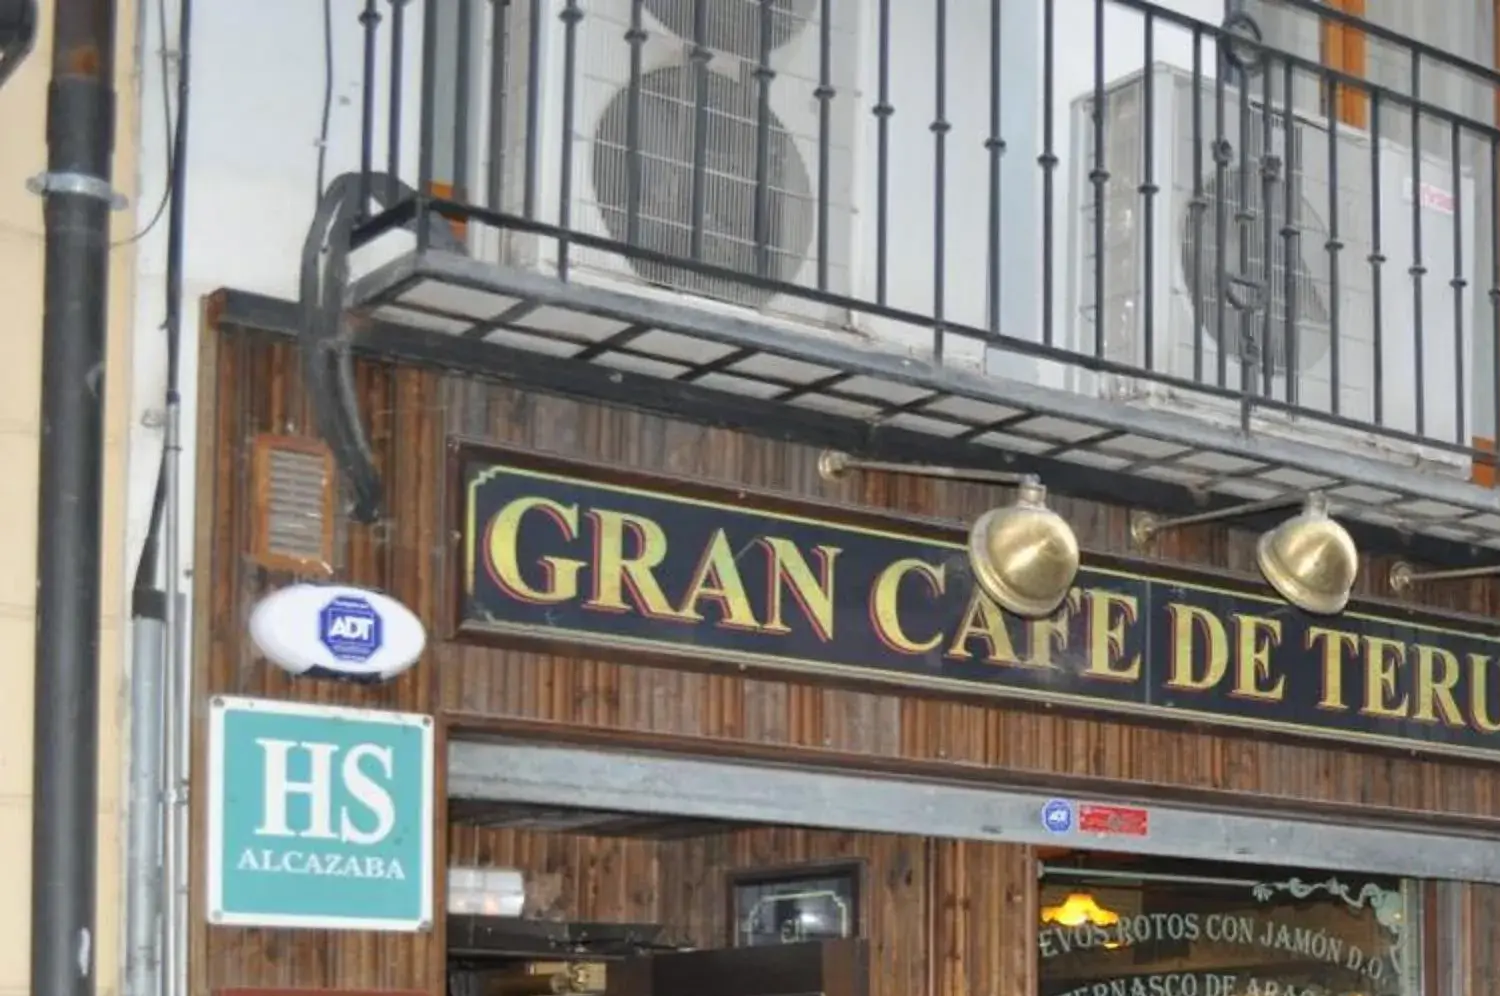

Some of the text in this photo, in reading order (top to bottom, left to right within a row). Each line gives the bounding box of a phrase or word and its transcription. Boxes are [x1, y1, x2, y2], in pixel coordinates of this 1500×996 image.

[483, 496, 842, 641] GRAN
[1167, 603, 1286, 701] DE
[329, 616, 373, 640] ADT
[254, 737, 395, 844] HS
[237, 849, 405, 880] ALCAZABA
[1117, 913, 1199, 946] ROTOS
[1206, 914, 1254, 944] CON
[1260, 921, 1343, 964] JAMÓN
